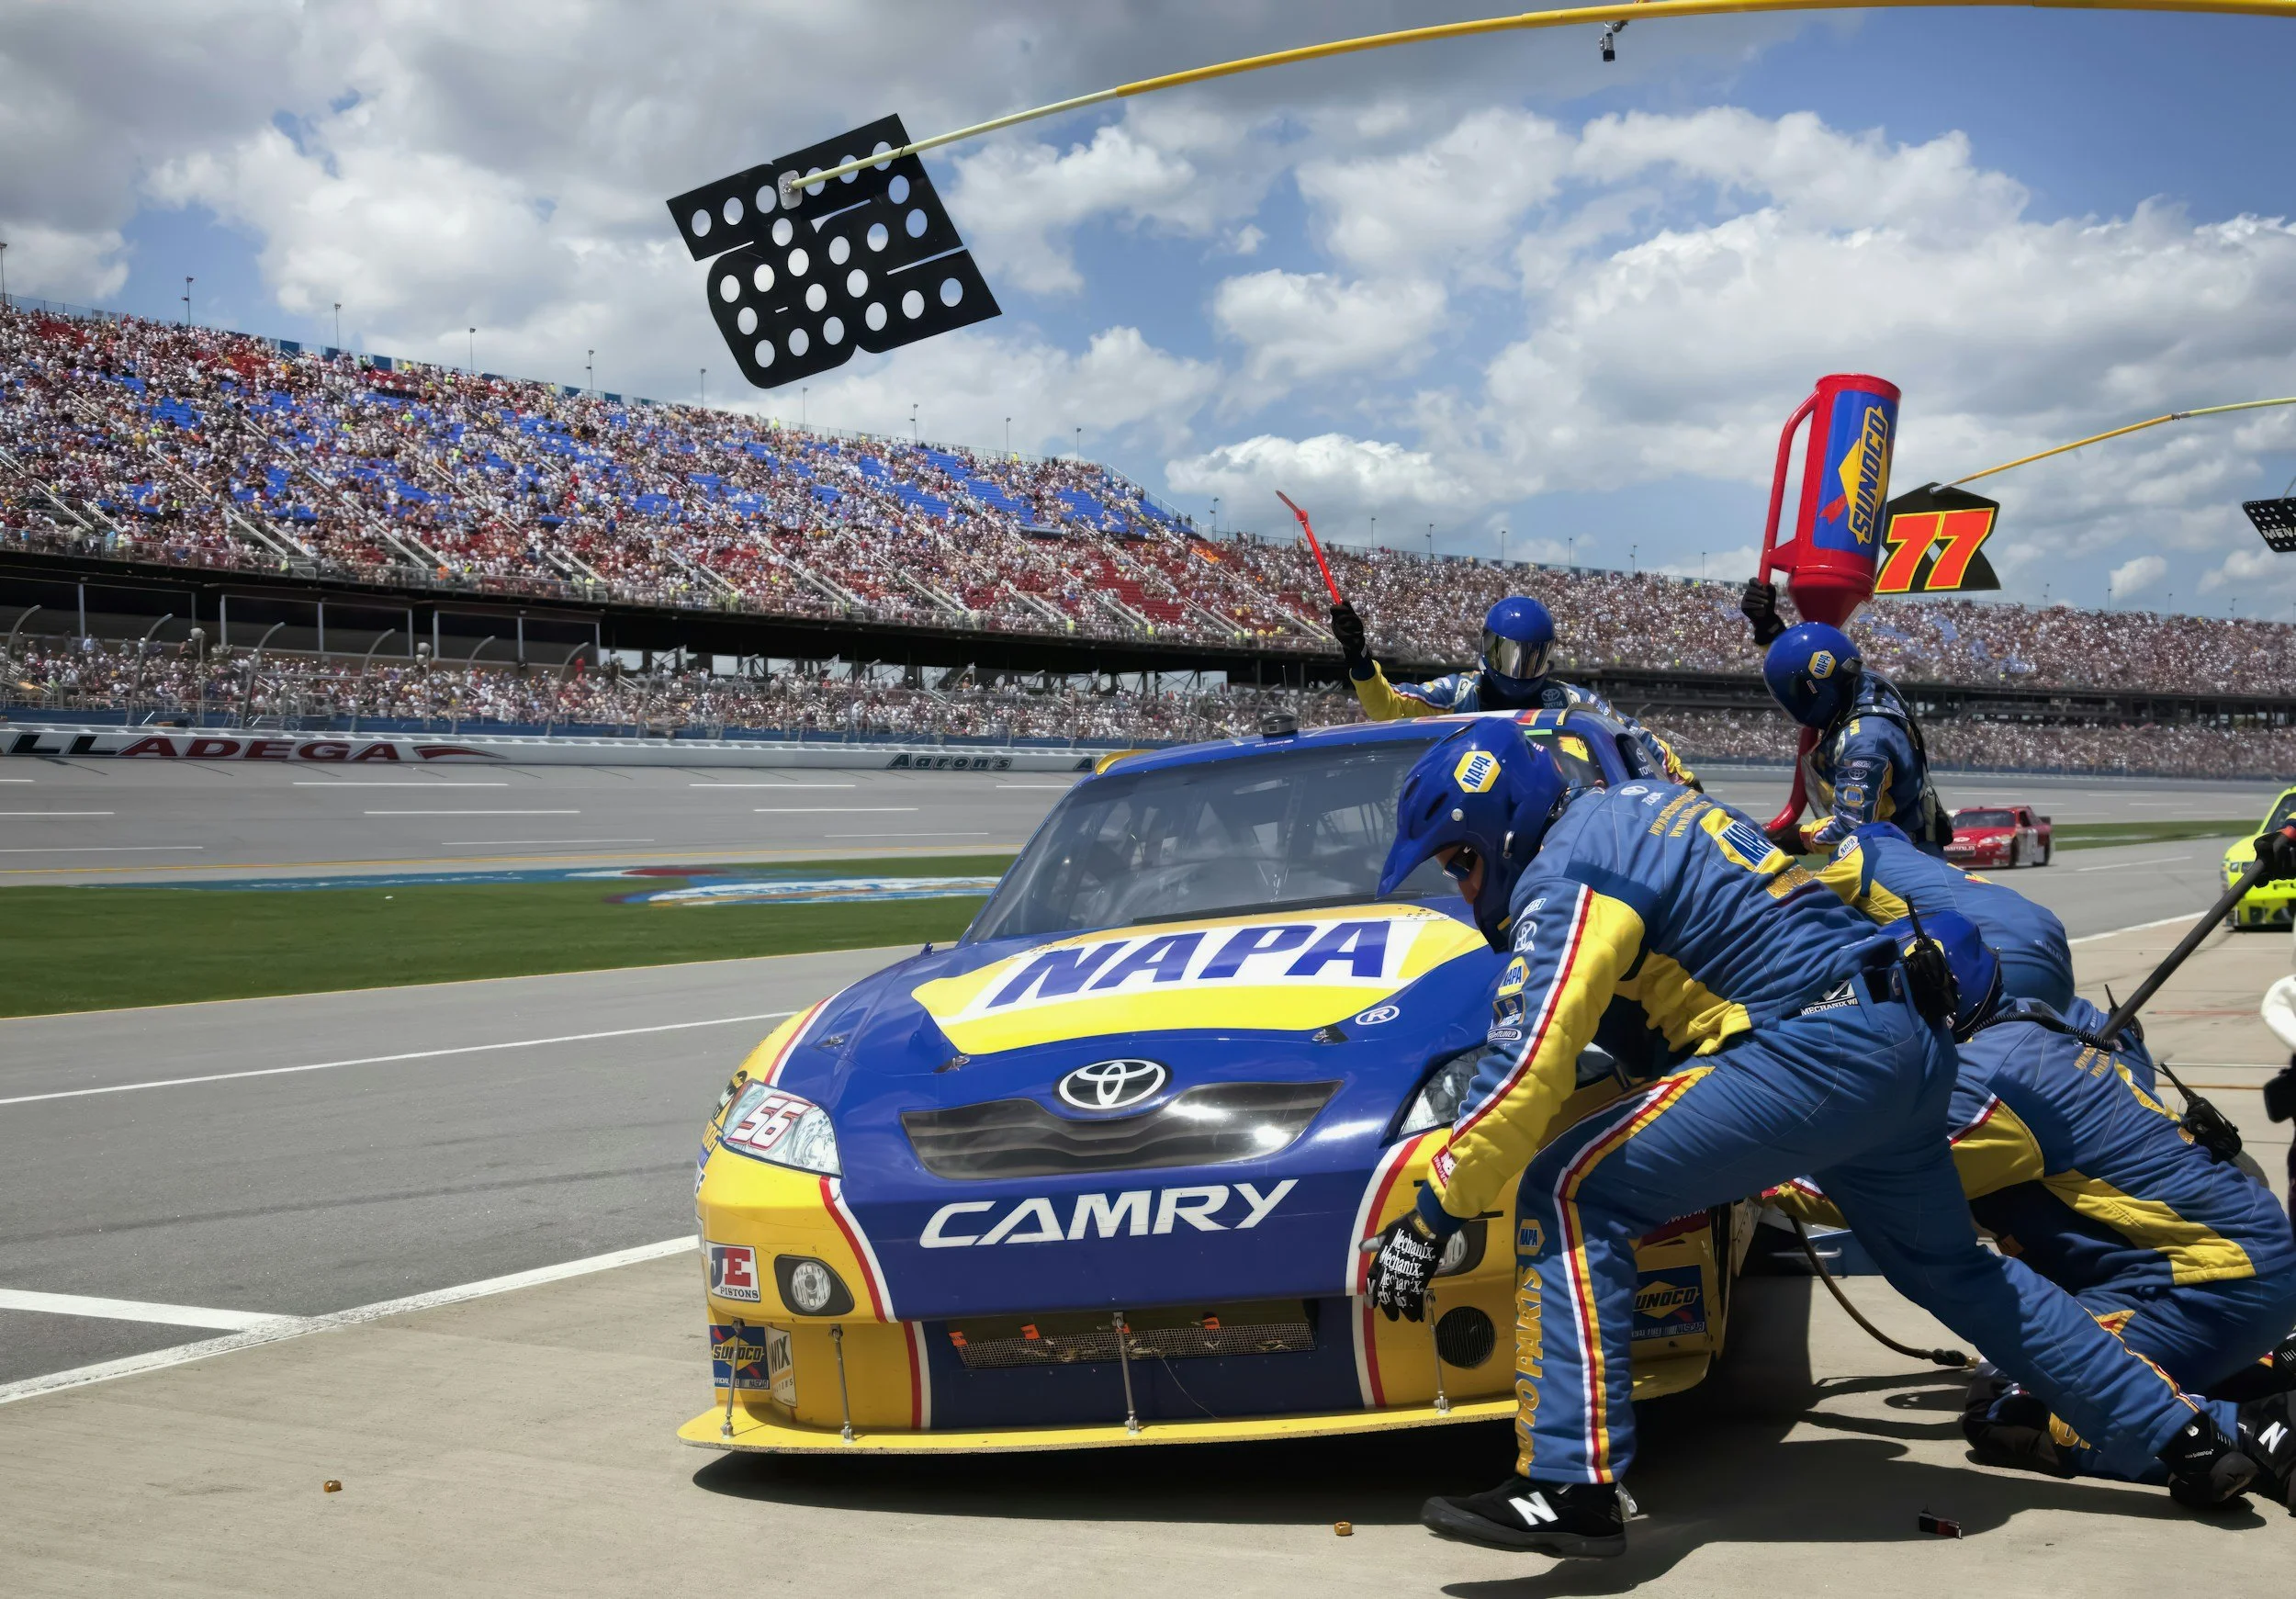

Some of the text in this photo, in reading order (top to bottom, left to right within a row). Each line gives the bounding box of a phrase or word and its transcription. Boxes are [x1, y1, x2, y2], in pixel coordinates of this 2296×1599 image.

[1851, 412, 1887, 542] SUNOCO
[2262, 526, 2296, 540] MEN
[1874, 507, 1995, 593] 77
[1814, 654, 1831, 676] NAPA
[0, 733, 402, 761] LLADEGA
[886, 752, 1013, 771] Aaron's
[1462, 755, 1491, 789] NAPA
[1840, 838, 1856, 855] NAPA
[985, 920, 1390, 1009] NAPA
[1801, 1001, 1847, 1017] MECHANIX
[726, 1095, 816, 1150] 56
[919, 1178, 1300, 1249] CAMRY
[1390, 1228, 1435, 1261] Mechanix
[711, 1246, 751, 1289] JE
[1379, 1245, 1424, 1278] Mechanix
[719, 1286, 760, 1300] PISTONS
[1635, 1288, 1697, 1309] UNOCO
[768, 1334, 791, 1375] WIX
